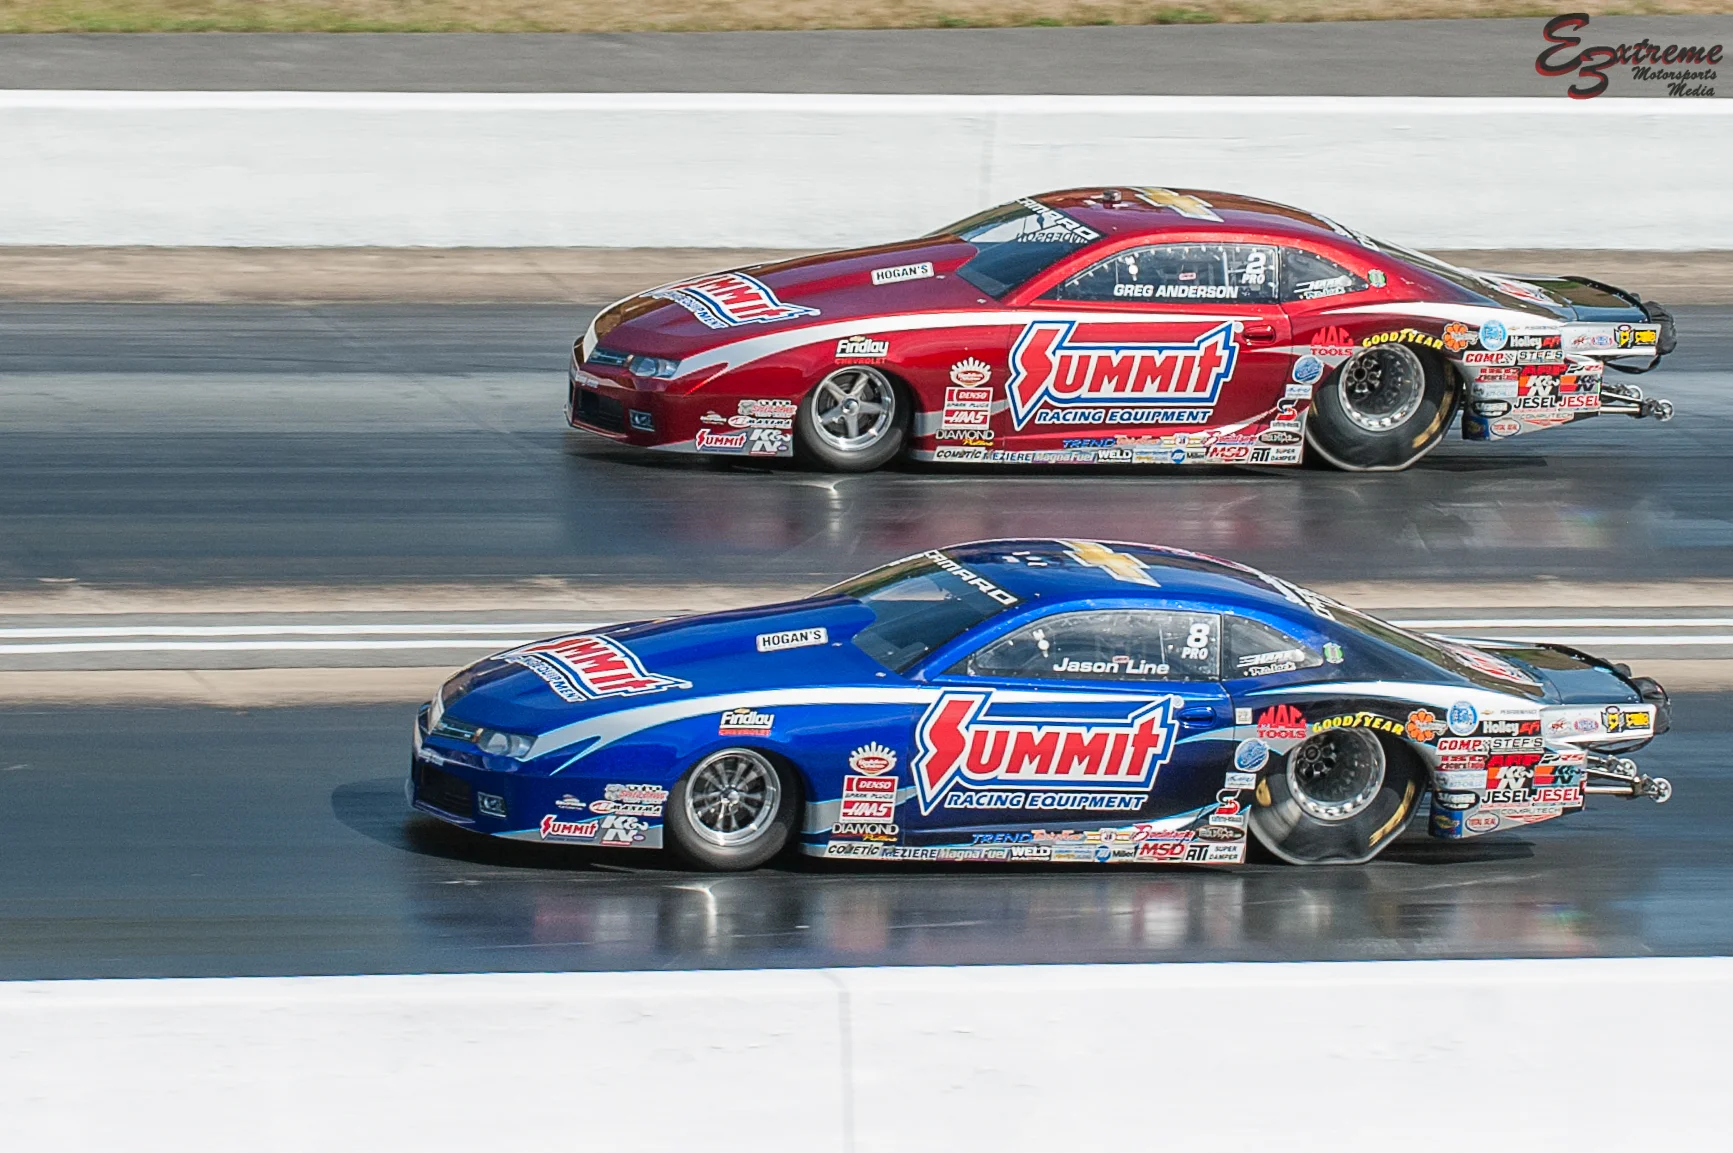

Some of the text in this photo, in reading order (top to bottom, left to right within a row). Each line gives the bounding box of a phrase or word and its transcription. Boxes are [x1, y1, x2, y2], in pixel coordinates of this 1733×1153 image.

[1246, 253, 1266, 274] 2
[876, 264, 928, 280] HOGAN'S
[1242, 274, 1265, 285] PRO
[1114, 284, 1239, 298] GREG ANDERSON
[836, 339, 889, 354] Findlay
[1510, 336, 1542, 349] Holley
[1311, 348, 1353, 356] TOOLS
[1465, 353, 1504, 363] COMP
[1514, 397, 1556, 409] JESEL
[1559, 395, 1599, 407] JESEL
[1037, 410, 1211, 423] RACING EQUIPMENT
[936, 430, 994, 440] DIAMOND
[1209, 446, 1249, 458] MSD
[1250, 448, 1272, 462] ATI
[924, 549, 1018, 606] CAMARO
[762, 630, 822, 647] HOGAN'S
[1187, 624, 1209, 648] 8
[1181, 648, 1208, 660] PRO
[1053, 657, 1170, 675] Jason Line
[721, 711, 774, 726] Findlay
[1257, 704, 1307, 728] MAC
[1312, 711, 1405, 735] GOODYEAR
[1483, 720, 1519, 737] Holley
[1257, 730, 1307, 739] TOOLS
[1439, 740, 1482, 750] COMP
[1493, 738, 1543, 748] STEF'S
[858, 781, 892, 789] DENSO
[1482, 790, 1530, 803] JESEL
[1533, 788, 1580, 801] JESEL
[947, 794, 1147, 809] RACING EQUIPMENT
[832, 824, 899, 834] DIAMOND
[972, 834, 1032, 843] TREND
[1010, 846, 1050, 856] WELD
[1139, 843, 1185, 856] MSD
[1186, 845, 1210, 861] ATI
